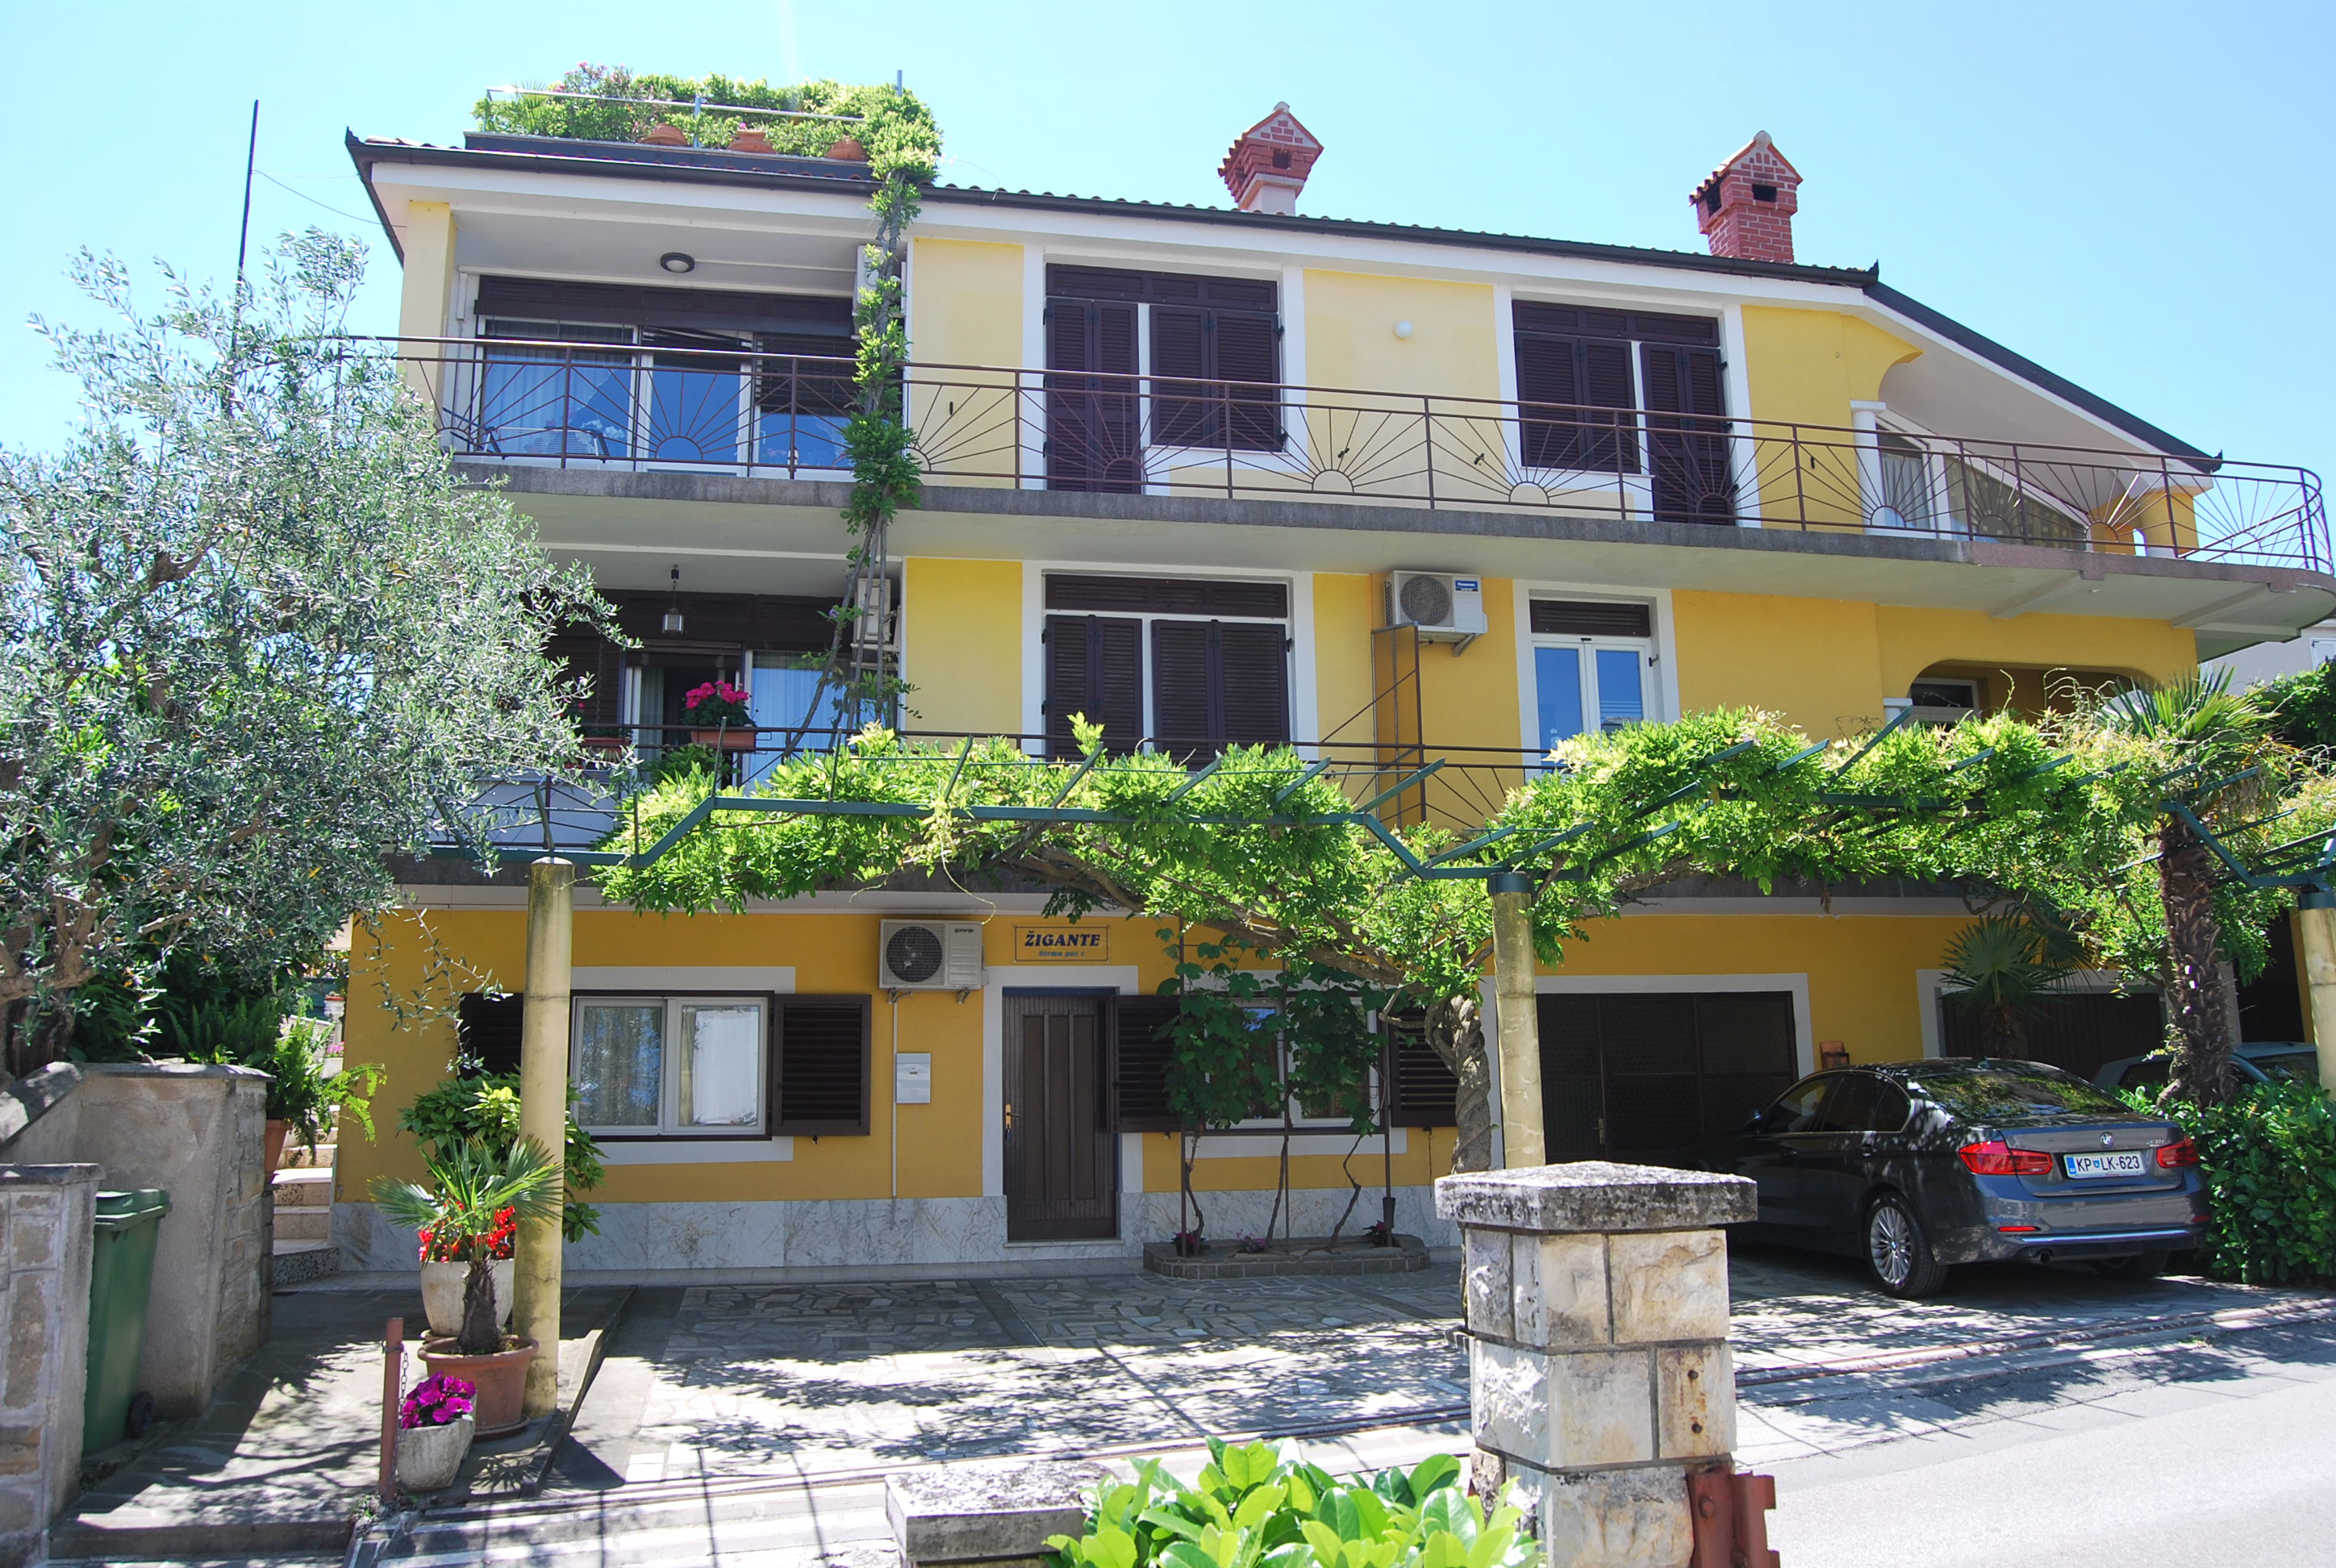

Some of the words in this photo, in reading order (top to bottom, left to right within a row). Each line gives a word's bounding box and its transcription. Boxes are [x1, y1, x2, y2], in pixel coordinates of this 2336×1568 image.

[1024, 930, 1100, 947] ŽIGANTE
[2075, 1157, 2092, 1172] KP
[2100, 1155, 2140, 1171] LK-623
